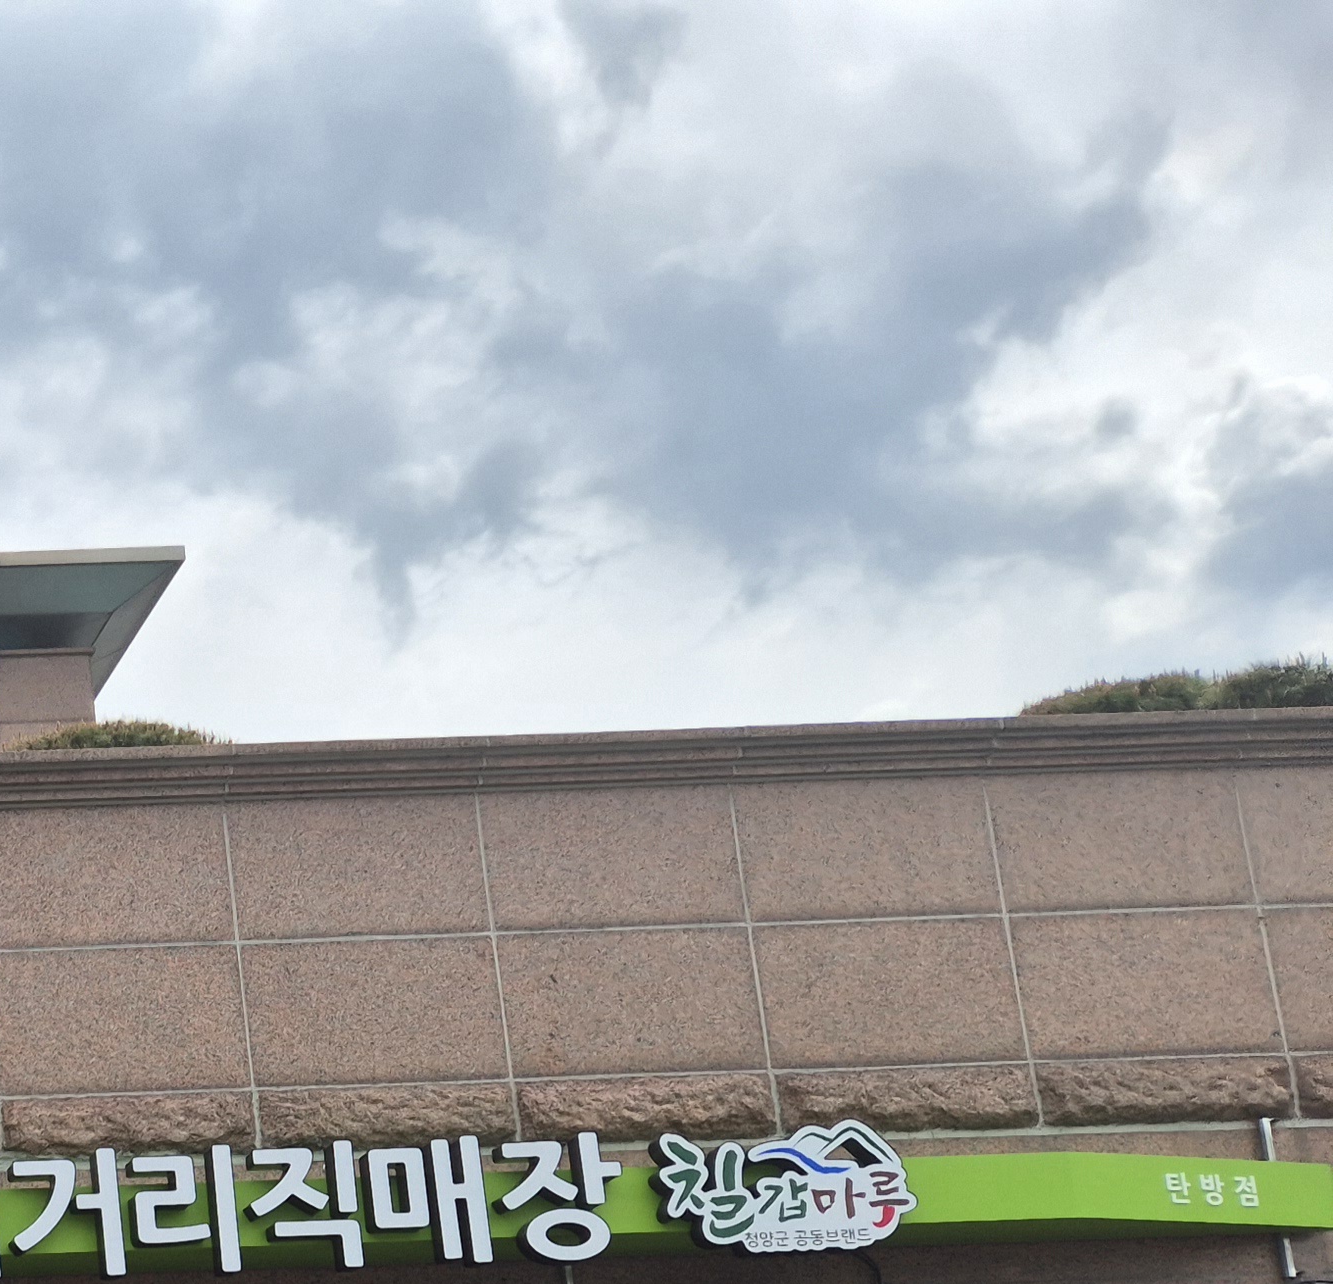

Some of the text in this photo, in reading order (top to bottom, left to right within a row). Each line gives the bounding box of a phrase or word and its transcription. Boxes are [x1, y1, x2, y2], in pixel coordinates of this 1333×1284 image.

[666, 1139, 910, 1239] 칠갑마루
[1164, 1172, 1260, 1208] 탄방점
[743, 1229, 872, 1249] 청양군 공동브랜드
